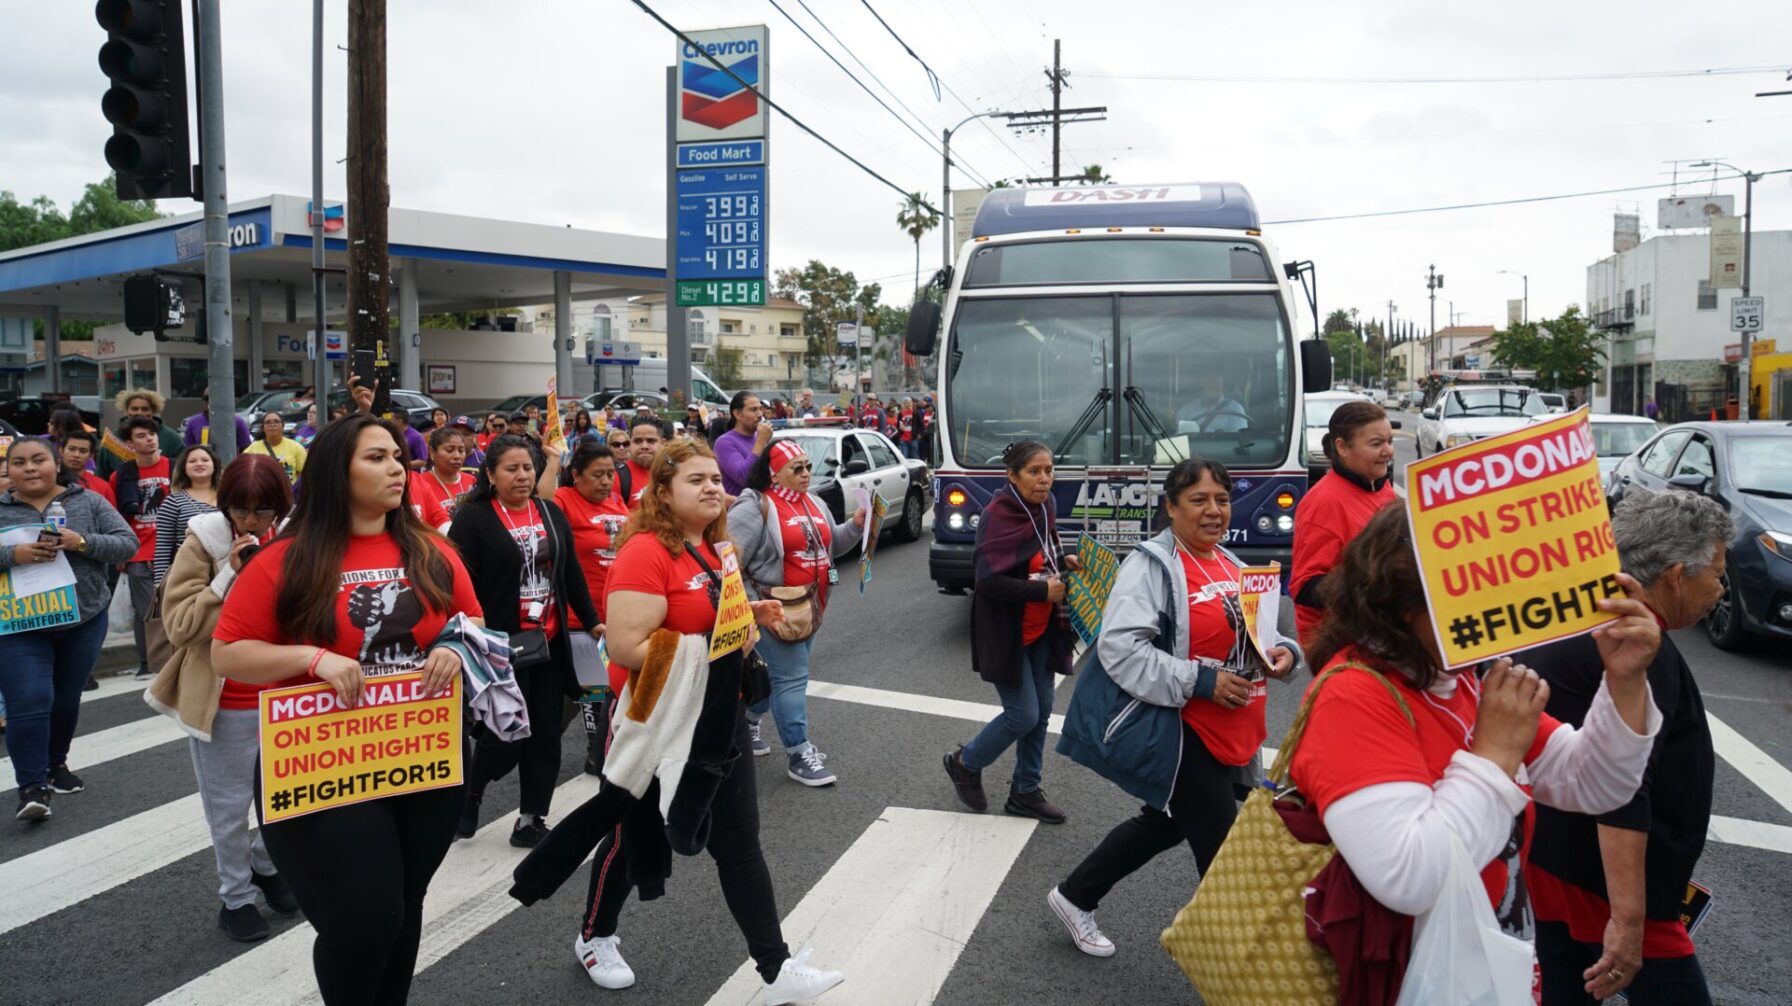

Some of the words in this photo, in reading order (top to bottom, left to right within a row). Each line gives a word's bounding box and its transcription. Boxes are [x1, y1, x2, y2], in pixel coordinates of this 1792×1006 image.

[683, 39, 758, 58] Chevron
[689, 148, 717, 161] Food
[722, 147, 751, 159] Mart
[680, 174, 705, 183] Gasoline
[725, 173, 737, 181] Self
[739, 172, 757, 180] Serve
[681, 286, 701, 294] Diesel
[1735, 315, 1760, 329] 35
[1420, 422, 1595, 507] MCDONAL
[1115, 508, 1157, 519] RANST
[1432, 510, 1490, 550] ON
[1496, 476, 1601, 533] STRIKE
[1441, 537, 1570, 597] UNION
[1573, 520, 1615, 563] RIG
[340, 570, 376, 584] NIONS
[378, 569, 400, 580] FOR
[1243, 574, 1280, 592] MCDON
[0, 589, 73, 621] SEXUAL
[1449, 574, 1620, 649] #FIGHTF
[2, 611, 75, 632] #FIGHTFOR15
[713, 624, 749, 652] #FIGHT
[362, 664, 394, 677] ICATOS
[274, 726, 311, 749] ON
[316, 712, 397, 743] STRIKE
[403, 706, 449, 728] FOR
[583, 703, 596, 731] NCE
[274, 746, 355, 779] UNION
[361, 732, 450, 762] RIGHTS
[271, 760, 451, 811] #FIGHTFOR15
